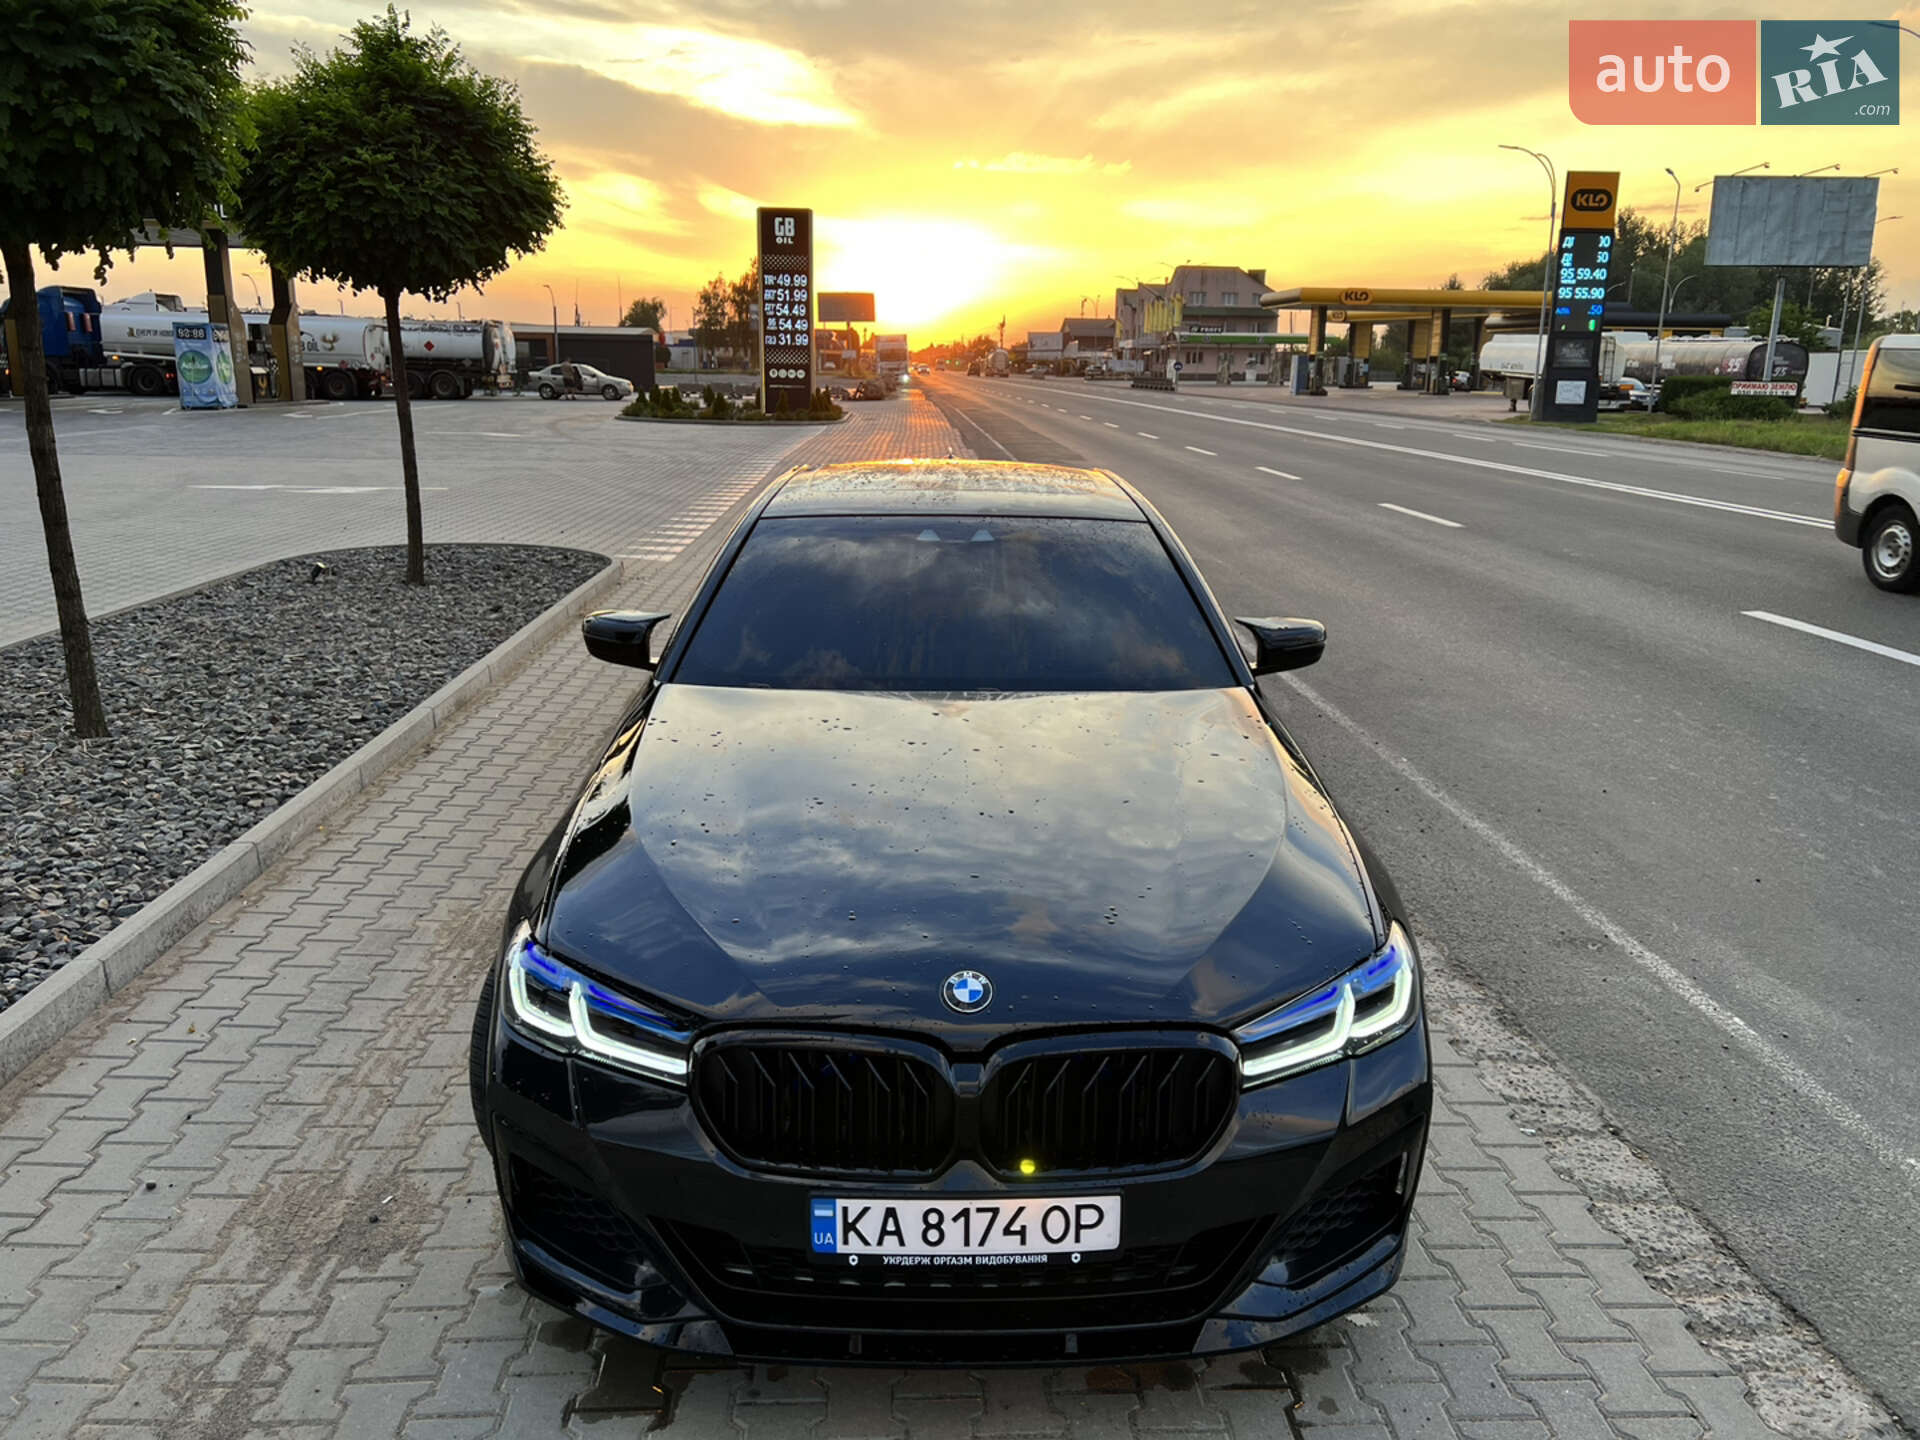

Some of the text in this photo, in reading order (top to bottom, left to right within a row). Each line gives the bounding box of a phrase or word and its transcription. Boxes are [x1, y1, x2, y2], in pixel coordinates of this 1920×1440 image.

[1575, 193, 1608, 207] KLO
[774, 217, 795, 236] GB
[776, 236, 793, 244] OIL
[777, 273, 808, 287] 49.99
[1560, 267, 1607, 280] 95 59.40
[777, 288, 808, 302] 51.99
[1344, 291, 1369, 301] KLO
[1558, 287, 1605, 299] 95 55.90
[776, 303, 806, 316] 54.49
[778, 318, 808, 331] 54.49
[778, 333, 808, 346] 31.99
[921, 1205, 1028, 1247] 8174
[814, 1231, 834, 1245] UA
[882, 1254, 1048, 1265] УКРДЕРЖ ОРГАЗМ ВИДОБУВАННЯ
